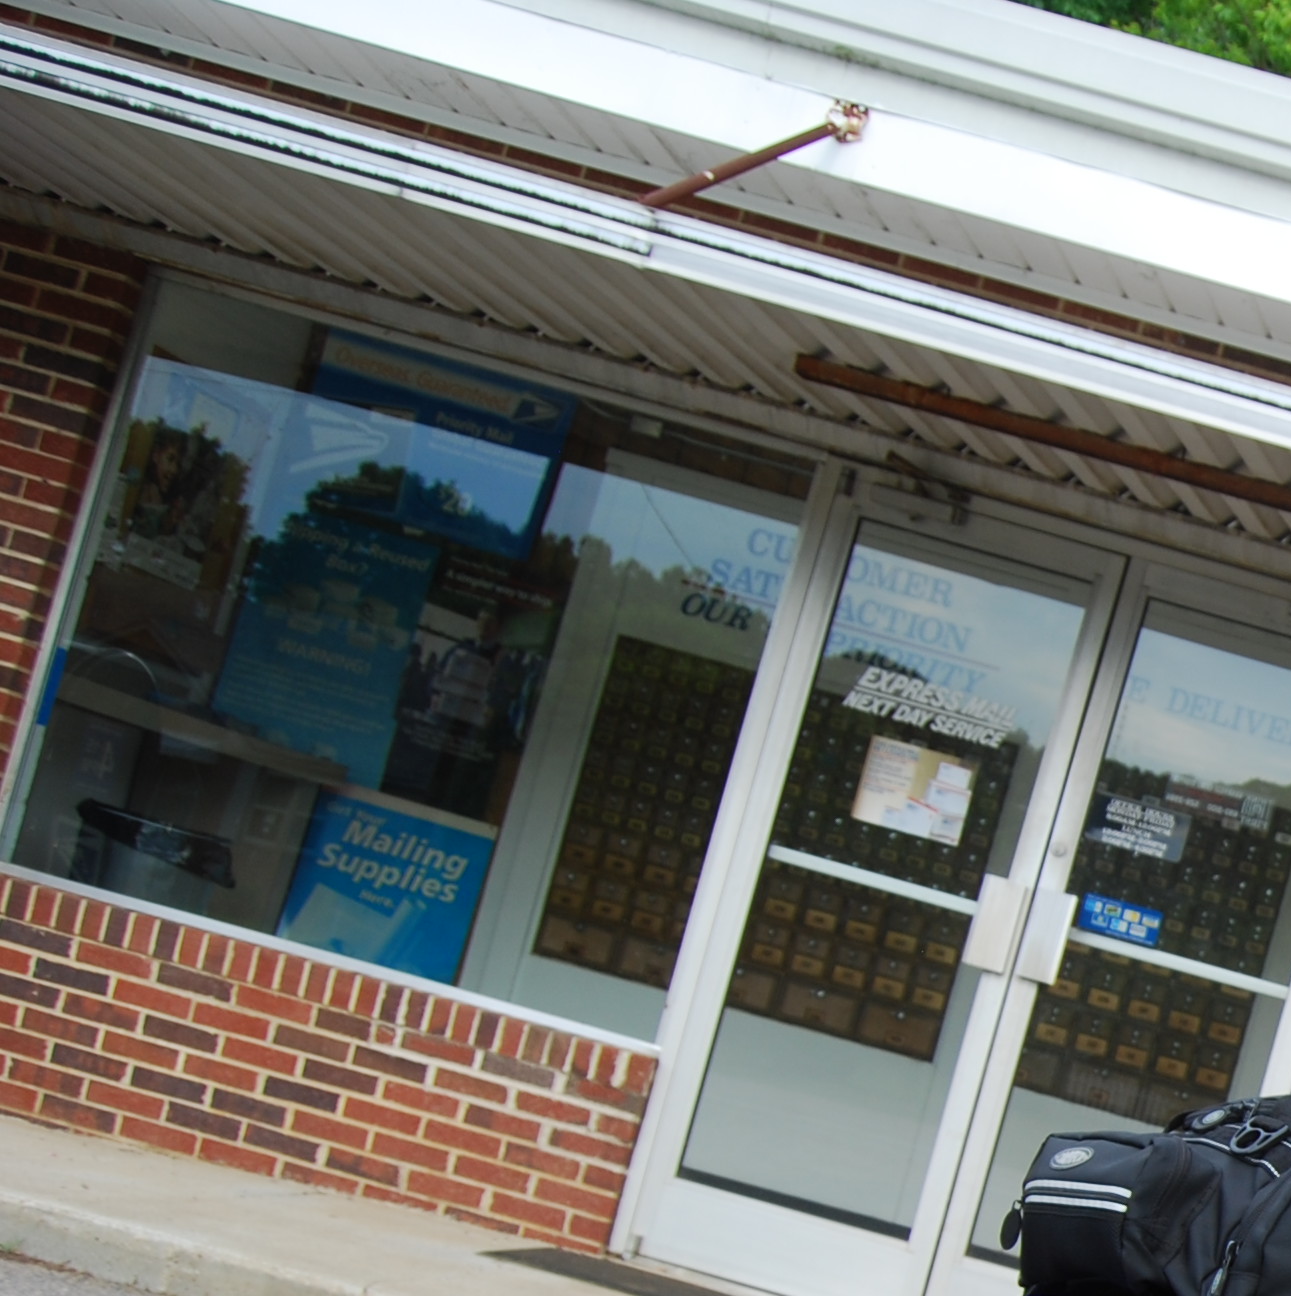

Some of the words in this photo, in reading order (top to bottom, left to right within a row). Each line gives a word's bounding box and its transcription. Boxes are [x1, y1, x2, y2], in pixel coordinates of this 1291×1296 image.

[747, 528, 954, 608] CUOMER
[681, 592, 751, 631] OUR
[710, 558, 974, 652] SATACTION
[842, 690, 897, 726] NEXT
[892, 703, 934, 728] DAY
[930, 713, 1006, 750] SERVICE
[857, 666, 966, 714] EXPRESS
[963, 694, 1018, 732] MAIL
[316, 843, 459, 903] Supplies
[342, 819, 469, 881] Mailing
